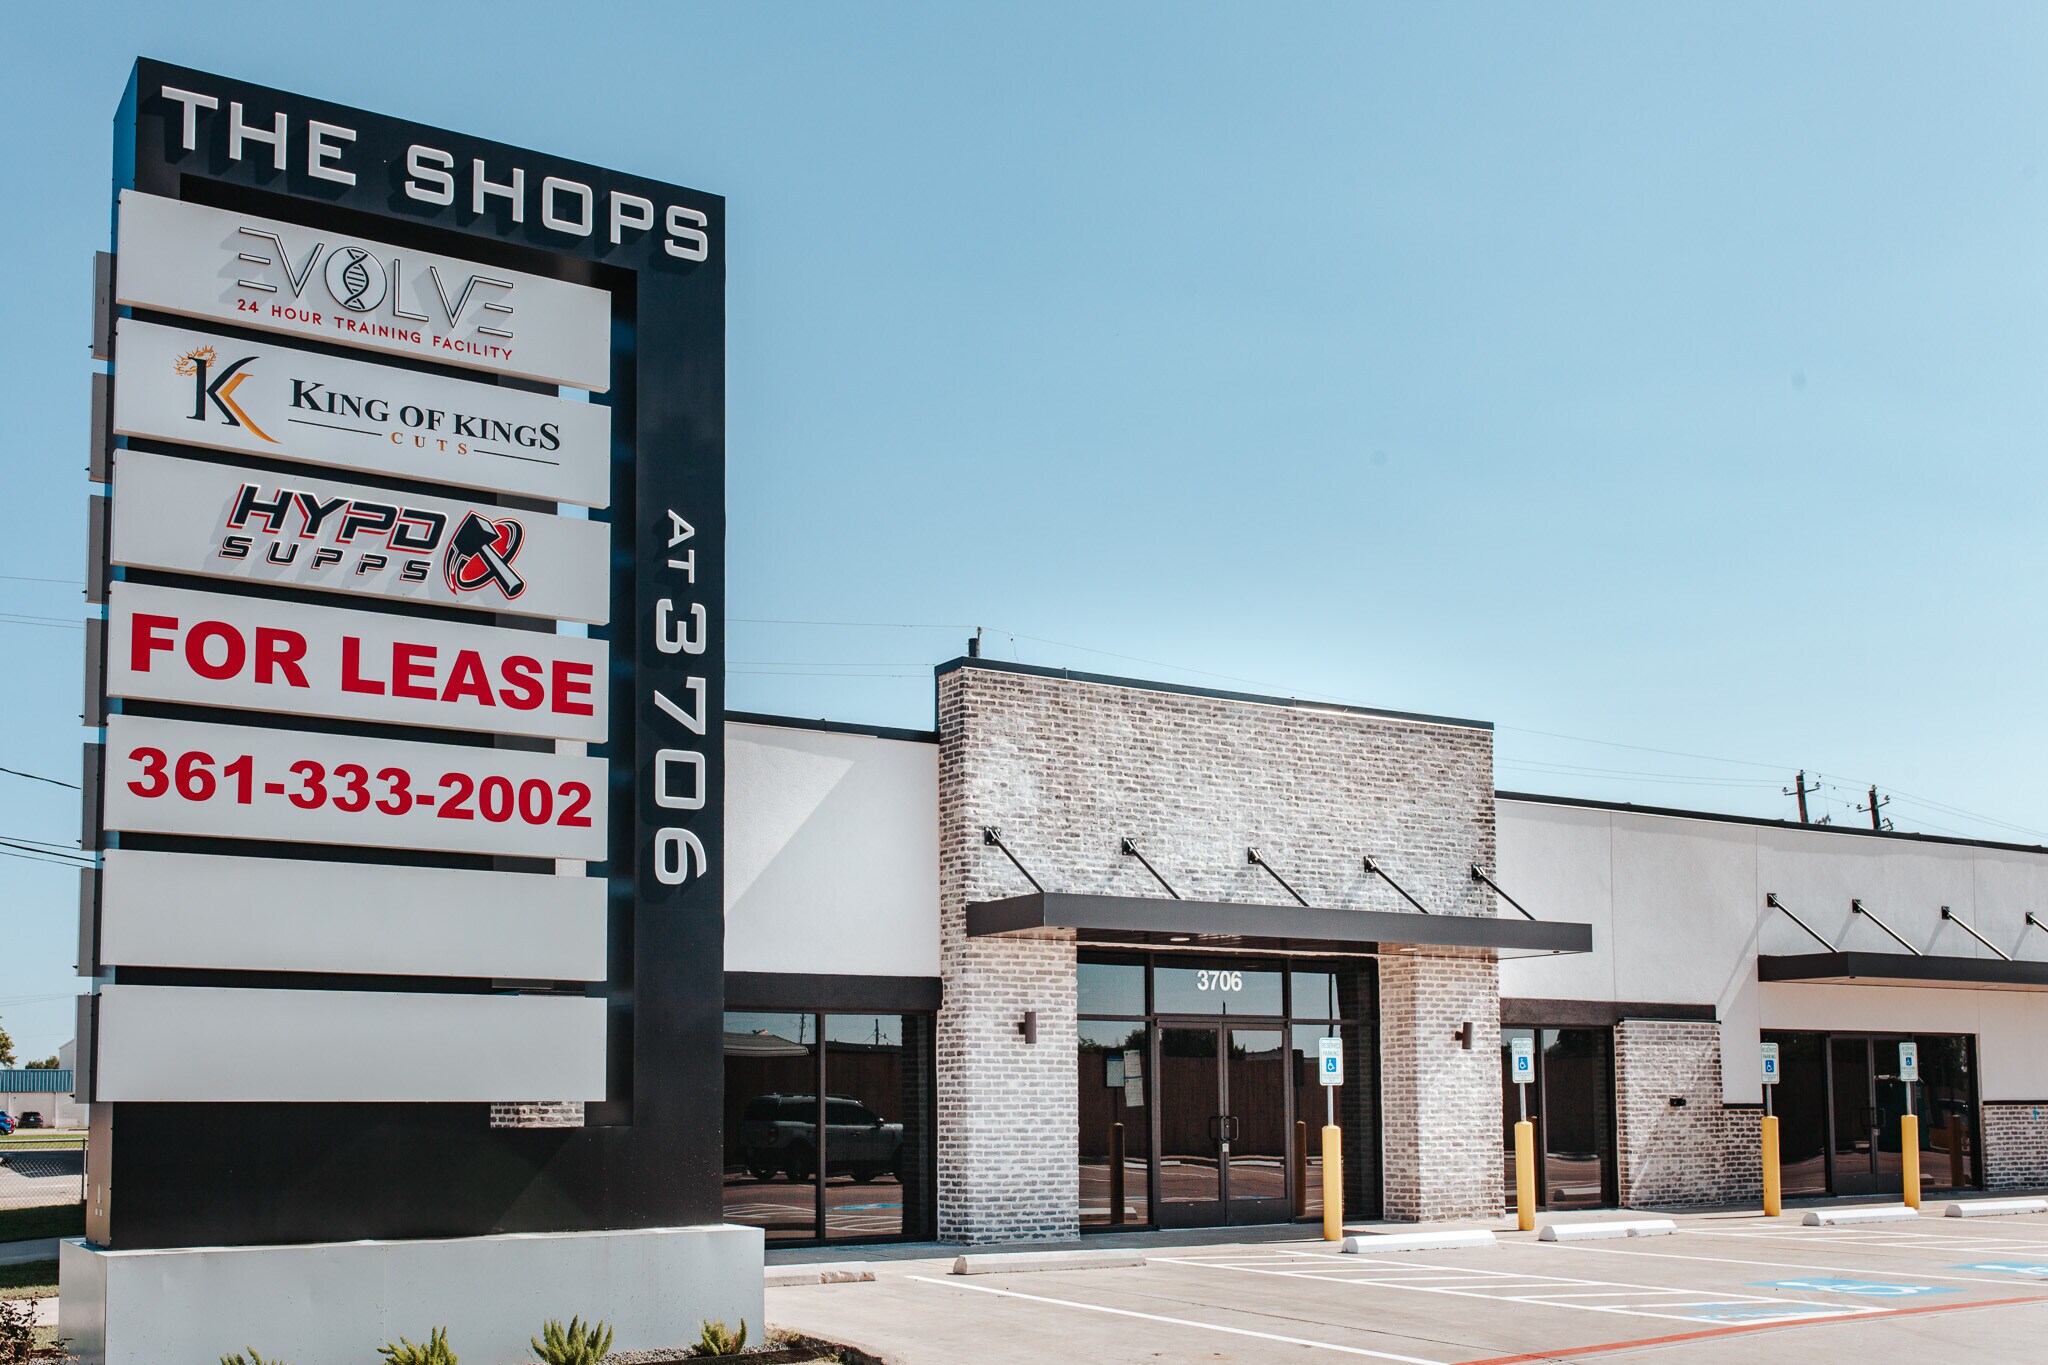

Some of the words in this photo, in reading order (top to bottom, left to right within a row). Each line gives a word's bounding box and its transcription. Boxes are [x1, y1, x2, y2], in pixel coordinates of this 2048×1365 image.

[162, 85, 356, 186] THE
[405, 144, 709, 262] SHOPS
[238, 226, 513, 338] EVOLVE
[237, 298, 259, 313] 24
[271, 304, 322, 325] HOUR
[334, 316, 422, 344] TRAINING
[433, 336, 513, 361] FACILITY
[288, 378, 389, 422] KING
[399, 404, 445, 431] OF
[453, 413, 560, 452] KINGS
[391, 431, 467, 456] CUTS
[218, 535, 432, 583] SUPPS
[668, 508, 696, 584] AT
[130, 613, 310, 689] FOR
[341, 636, 594, 717] LEASE
[654, 598, 707, 885] 3706
[127, 747, 592, 828] 361-333-2002
[1197, 970, 1243, 991] 3706
